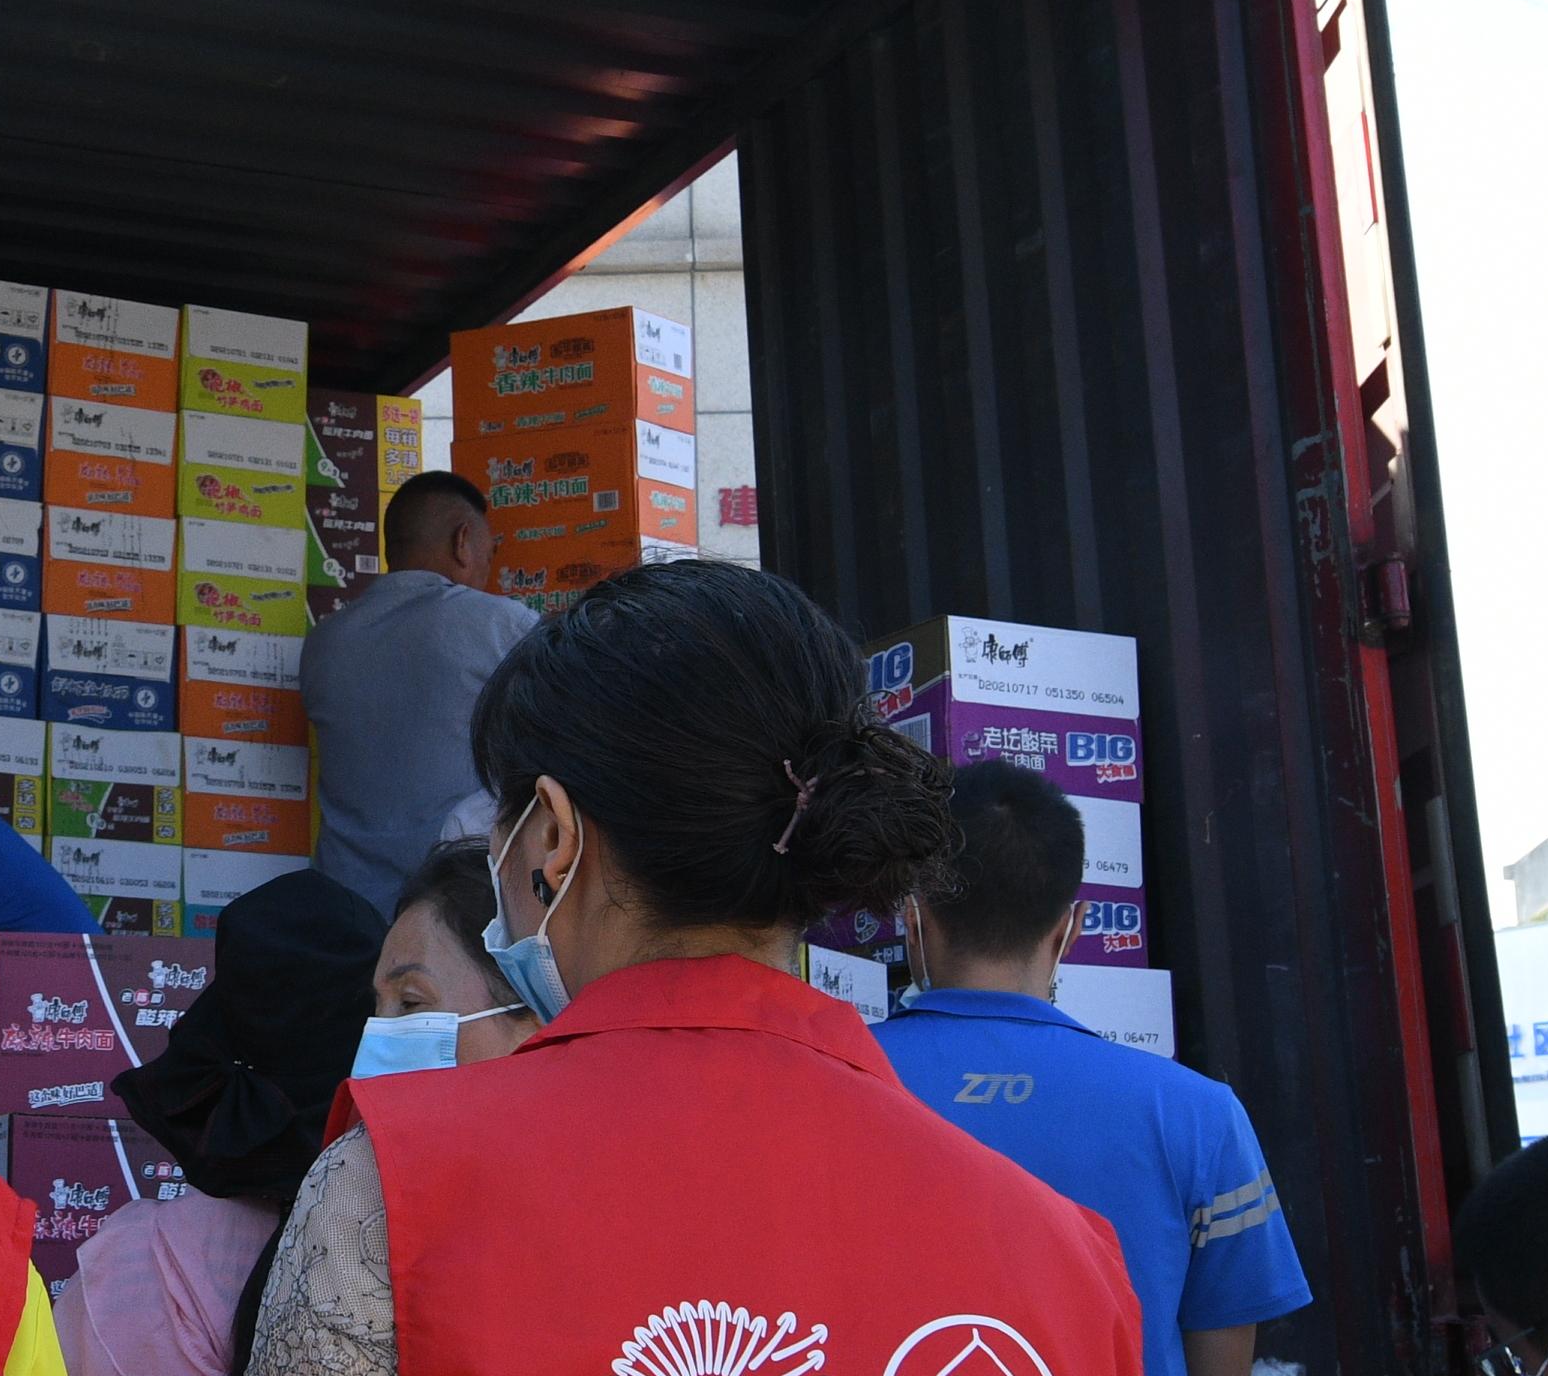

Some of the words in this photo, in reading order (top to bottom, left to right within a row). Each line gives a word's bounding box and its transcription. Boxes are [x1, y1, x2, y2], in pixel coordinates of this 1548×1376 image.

[490, 360, 594, 397] 香辣牛肉面
[488, 475, 590, 509] 香辣牛肉面
[978, 679, 1039, 697] D20210717
[1045, 686, 1086, 702] 051350
[1091, 692, 1125, 706] 06504
[983, 726, 1058, 755] 老坛酸菜
[1066, 732, 1136, 766] BIG
[1096, 860, 1129, 874] 06479
[1081, 901, 1142, 937] BIG
[135, 1008, 186, 1030] 酸辣
[1, 1023, 115, 1052] 麻辣牛肉面
[1124, 1031, 1160, 1045] 06477
[953, 1072, 1034, 1105] ZTO
